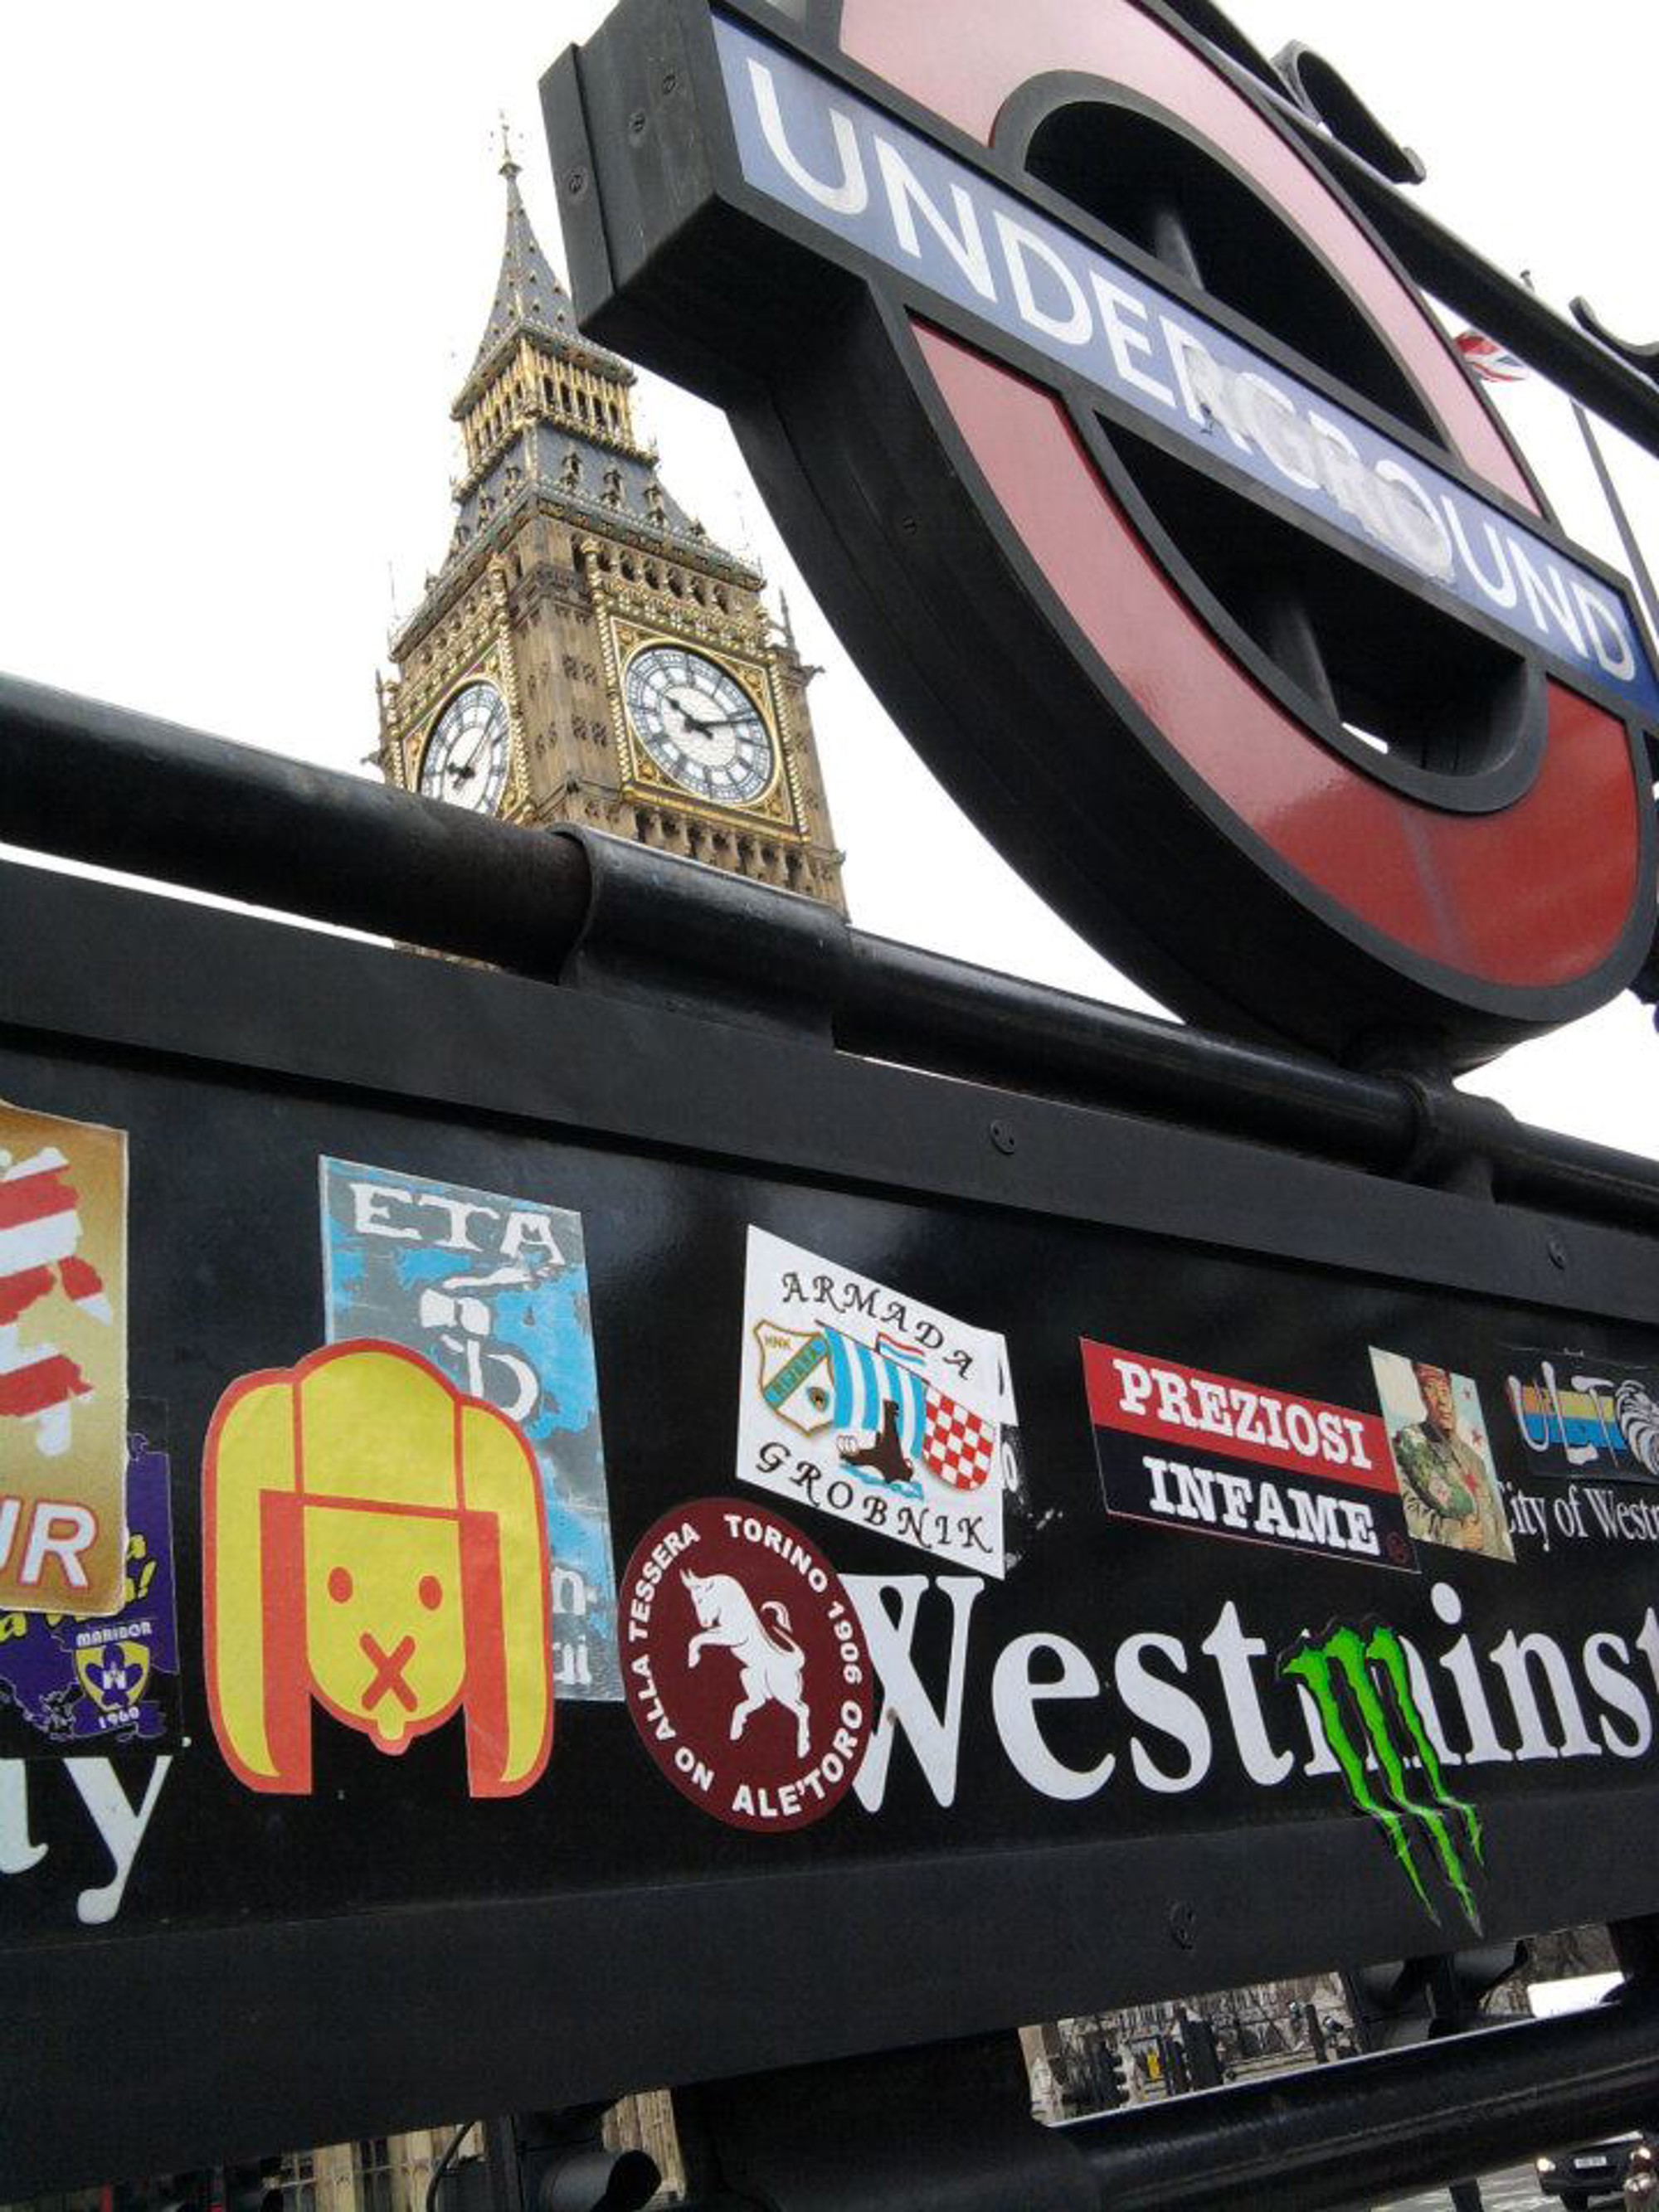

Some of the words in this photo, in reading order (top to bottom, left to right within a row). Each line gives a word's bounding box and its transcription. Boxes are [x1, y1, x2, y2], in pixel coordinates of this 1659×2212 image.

[349, 1182, 566, 1266] ETA
[782, 1271, 976, 1380] ARMADA
[1113, 1358, 1373, 1471] PREZIOSI
[756, 1441, 994, 1553] GROBNIK
[1142, 1456, 1381, 1557] INFAME
[1554, 1484, 1589, 1539] of
[629, 1522, 702, 1642] TESSERA
[723, 1514, 828, 1593] TORINO
[828, 1601, 863, 1685] 1906
[76, 1621, 153, 1647] MARIBOR
[632, 1655, 677, 1742] ALLA
[674, 1745, 714, 1791] NO
